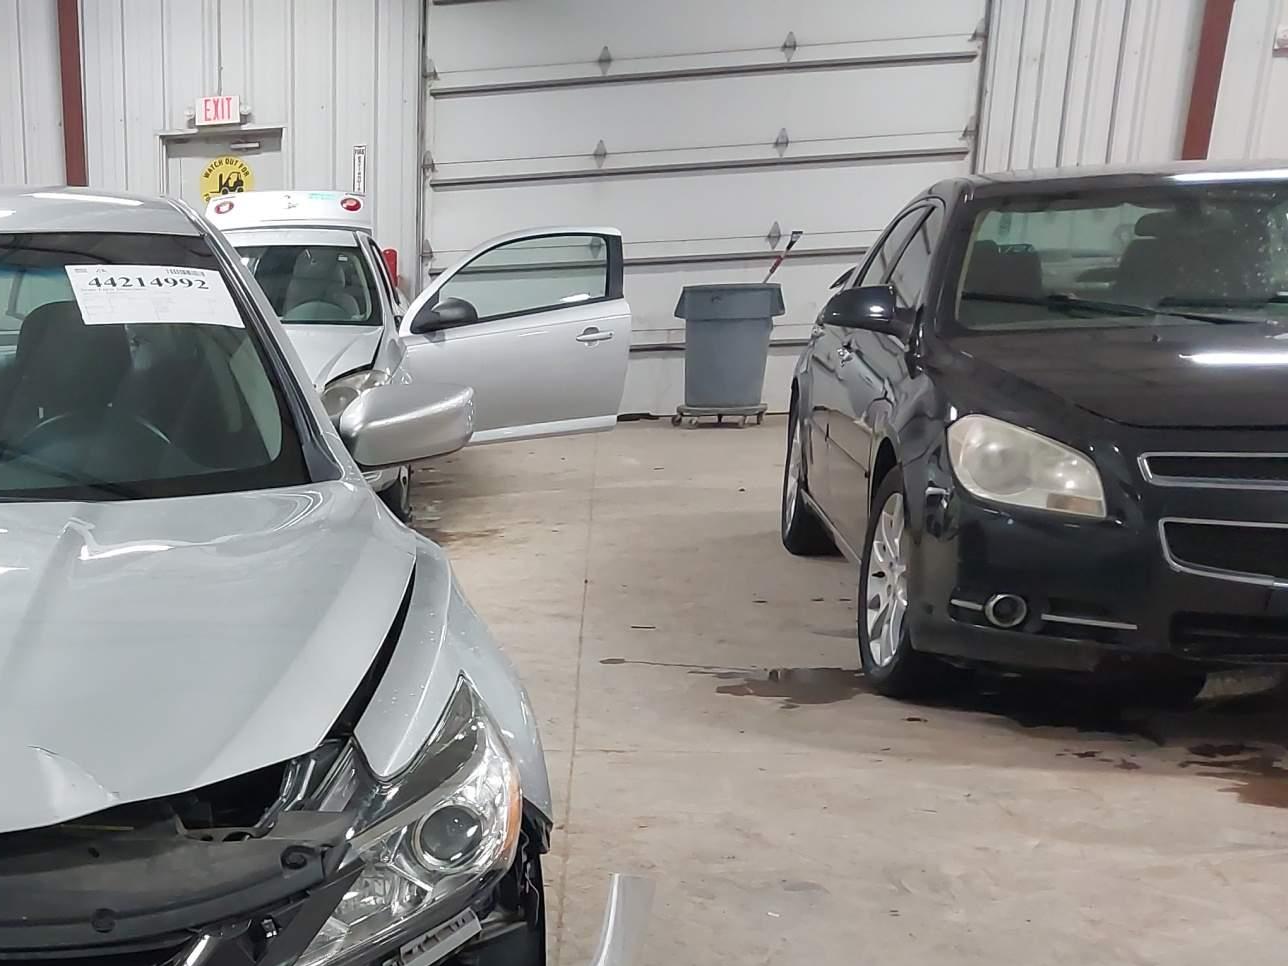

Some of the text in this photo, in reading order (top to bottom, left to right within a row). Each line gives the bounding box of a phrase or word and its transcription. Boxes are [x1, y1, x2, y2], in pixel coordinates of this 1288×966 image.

[203, 97, 232, 121] EXIT
[203, 158, 250, 178] WATCH OUT FOR
[88, 276, 209, 290] 44214992
